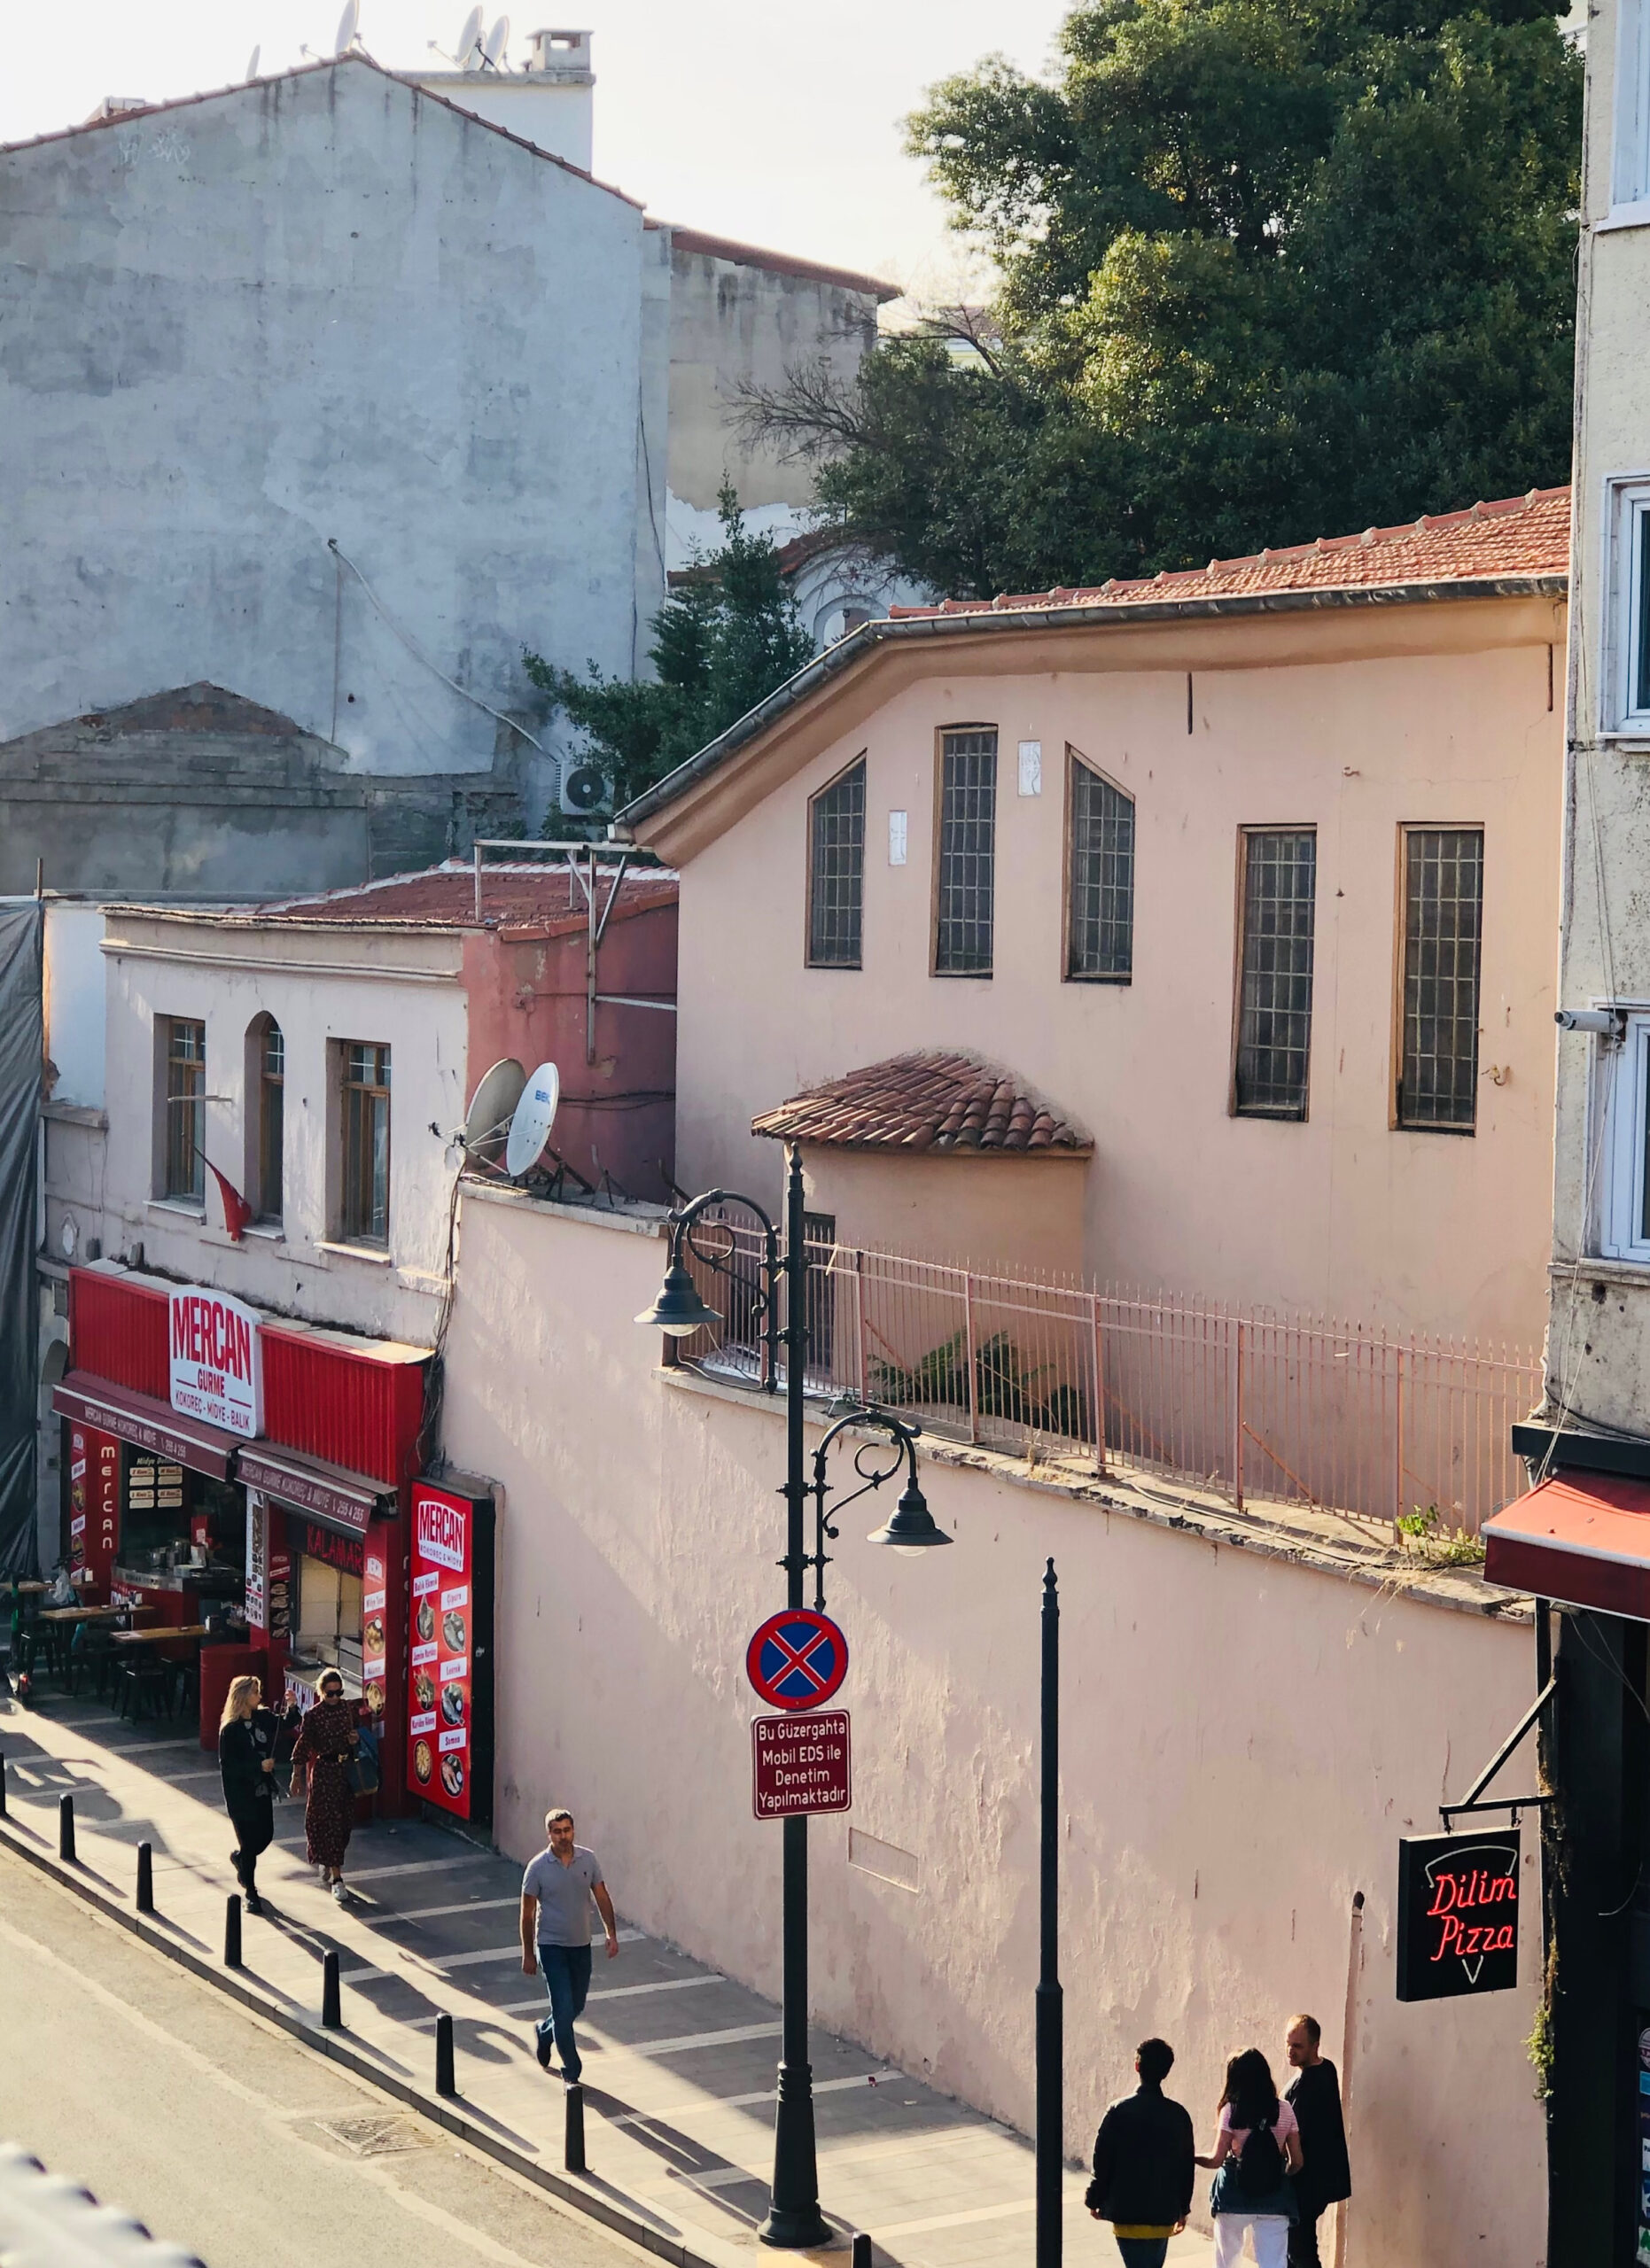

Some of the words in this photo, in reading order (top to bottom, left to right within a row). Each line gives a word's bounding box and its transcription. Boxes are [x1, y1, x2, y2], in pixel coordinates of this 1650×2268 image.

[173, 1296, 251, 1386] MERCAN
[198, 1368, 225, 1398] GURME
[175, 1390, 202, 1414] KOKOREÇ
[230, 1410, 251, 1431] BALIK
[307, 1524, 363, 1574] KALAMAR
[420, 1504, 463, 1557] MERCAN
[759, 1725, 774, 1741] Bu
[777, 1719, 845, 1740] Güzergahta
[762, 1747, 796, 1766] Mobil
[799, 1745, 824, 1762] EDS
[827, 1744, 841, 1760] ile
[775, 1767, 829, 1786] Denetim
[759, 1785, 845, 1812] Yapılmaktadır
[1427, 1869, 1517, 1915] Dilim
[1430, 1915, 1514, 1961] Pizza
